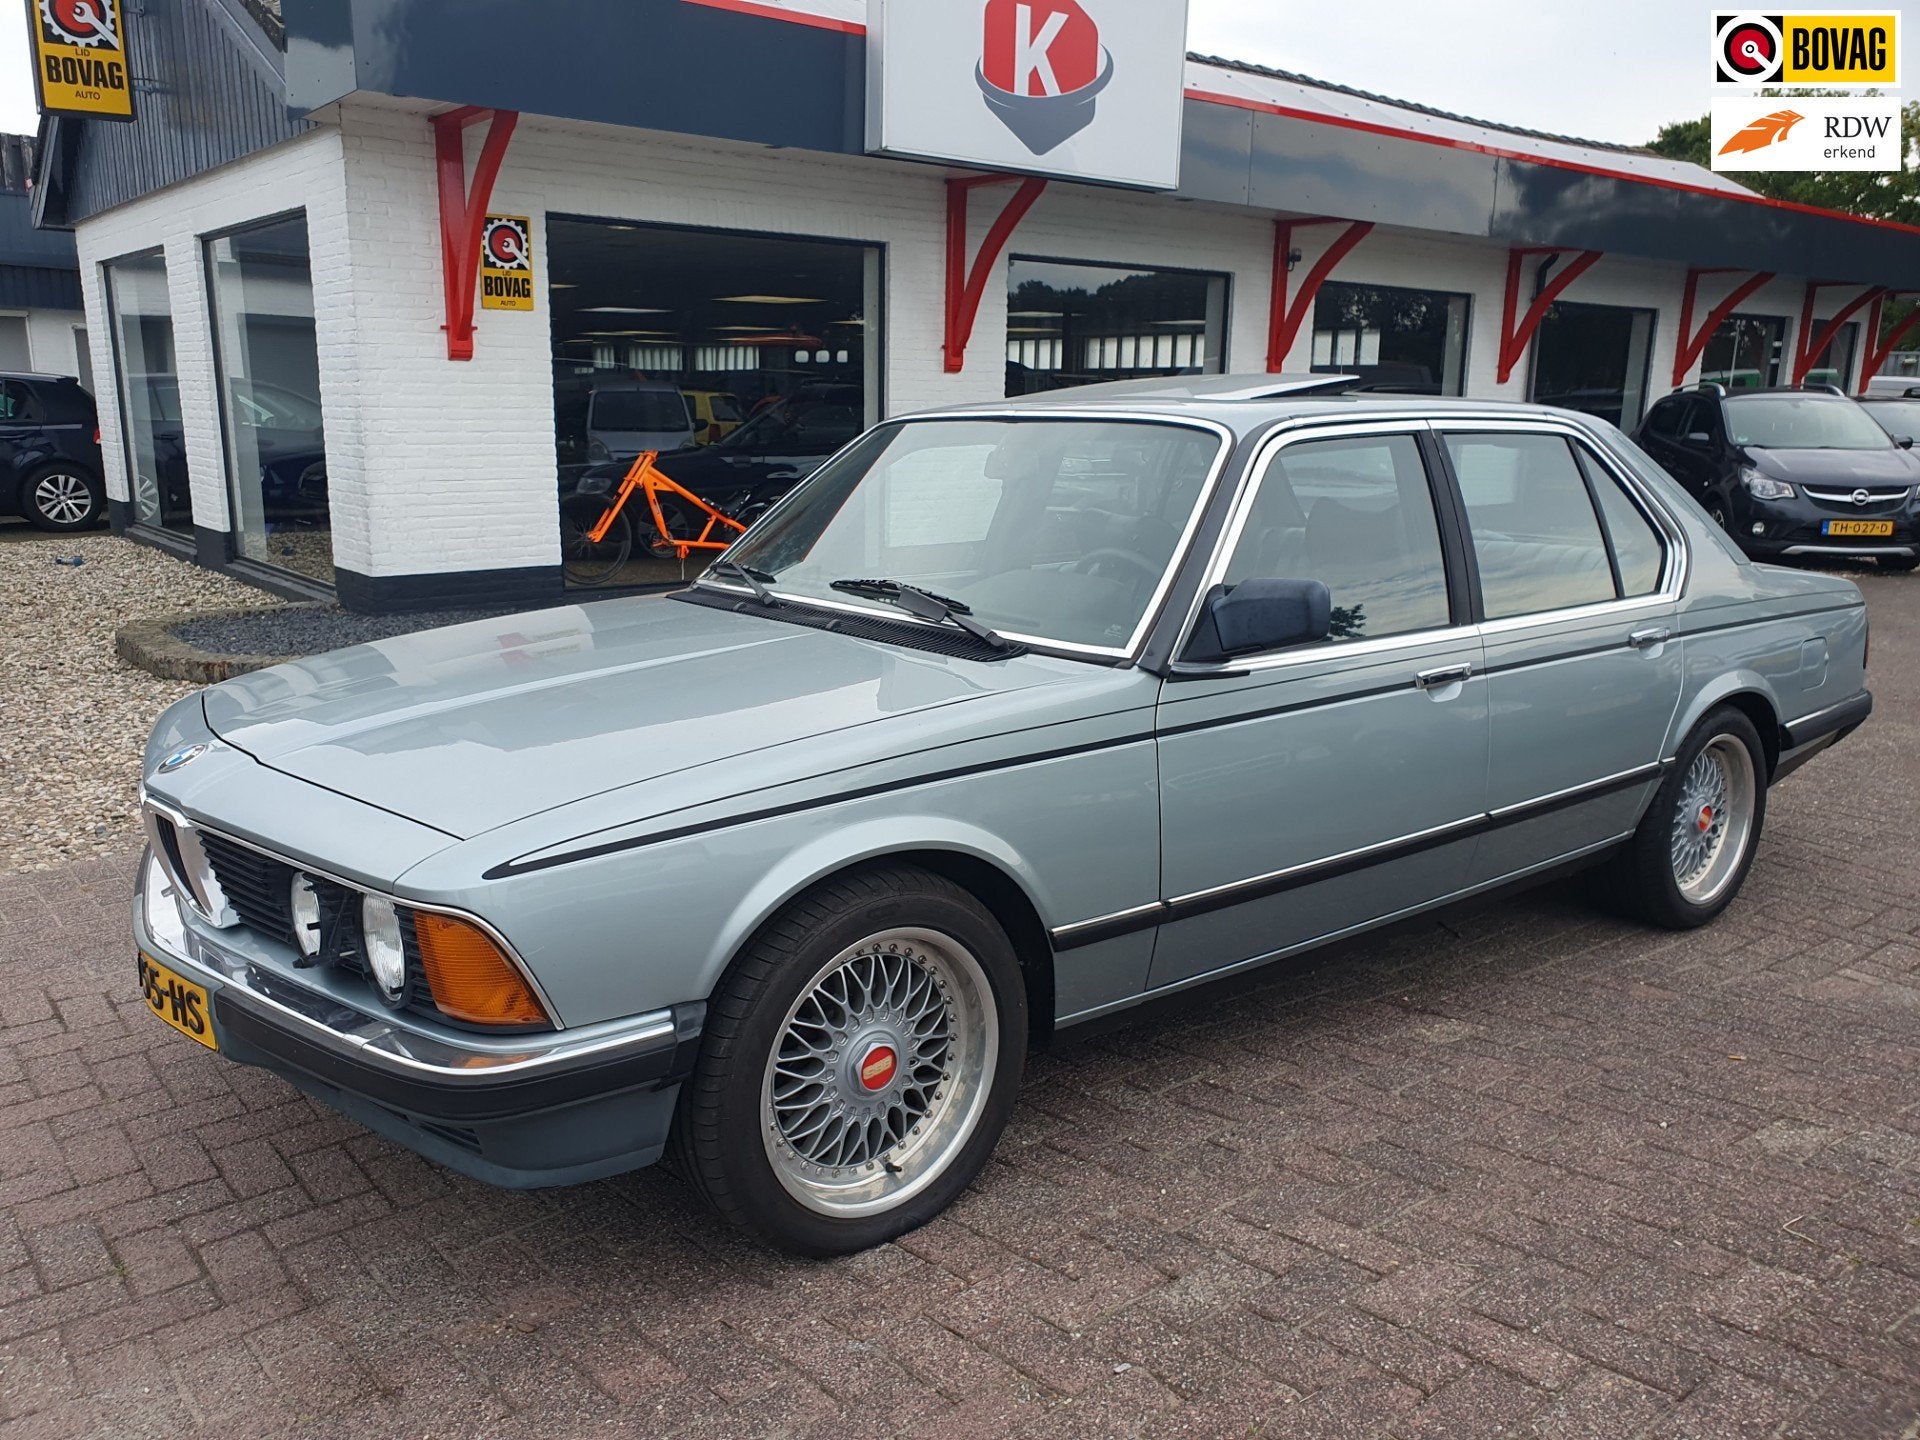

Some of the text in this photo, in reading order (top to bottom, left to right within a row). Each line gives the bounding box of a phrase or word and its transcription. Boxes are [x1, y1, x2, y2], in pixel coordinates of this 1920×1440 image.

[75, 48, 90, 57] LID
[1013, 2, 1069, 97] K
[45, 54, 124, 90] BOVAG
[75, 90, 101, 101] AUTO
[483, 275, 531, 299] BOVAG
[1832, 522, 1888, 534] TH-027-D
[138, 952, 204, 1035] 55-HS
